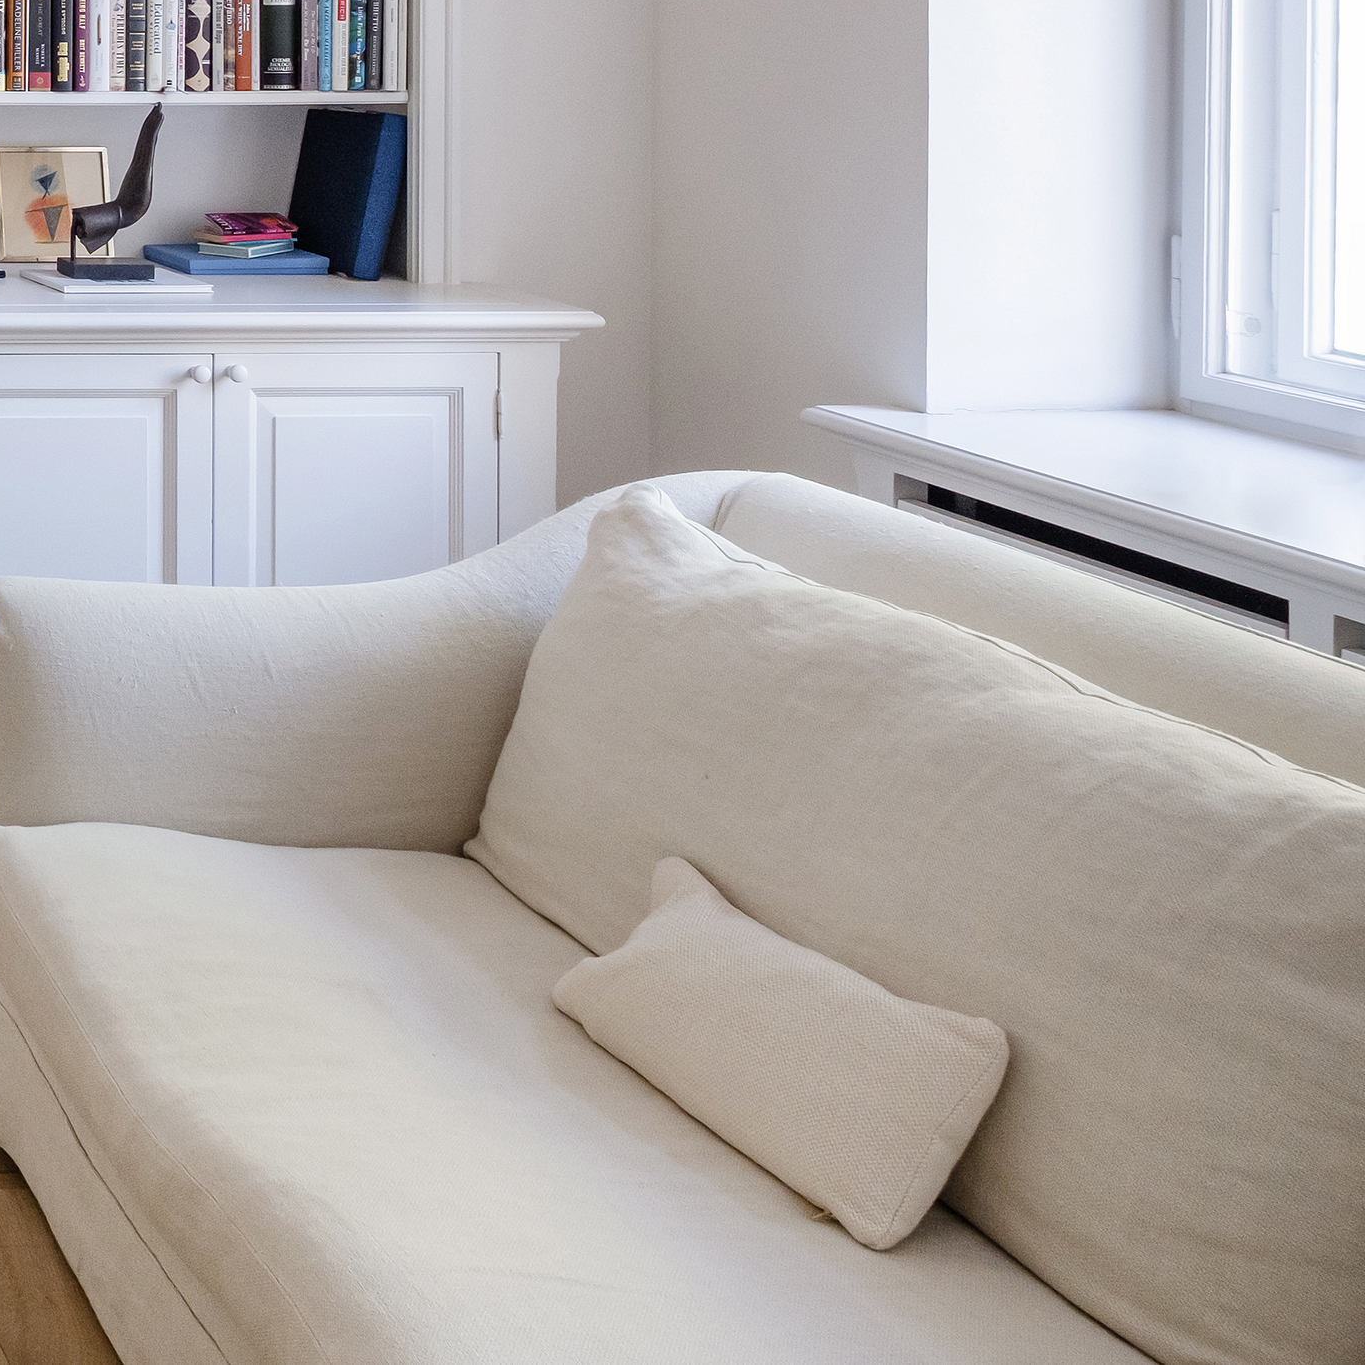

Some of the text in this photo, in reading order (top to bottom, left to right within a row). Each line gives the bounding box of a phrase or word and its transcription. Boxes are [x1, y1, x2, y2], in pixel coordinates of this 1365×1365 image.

[154, 4, 162, 54] Educated
[372, 2, 380, 32] BHUTTO
[116, 13, 124, 74] PERILOUS TIMES
[355, 38, 363, 75] Everywhere
